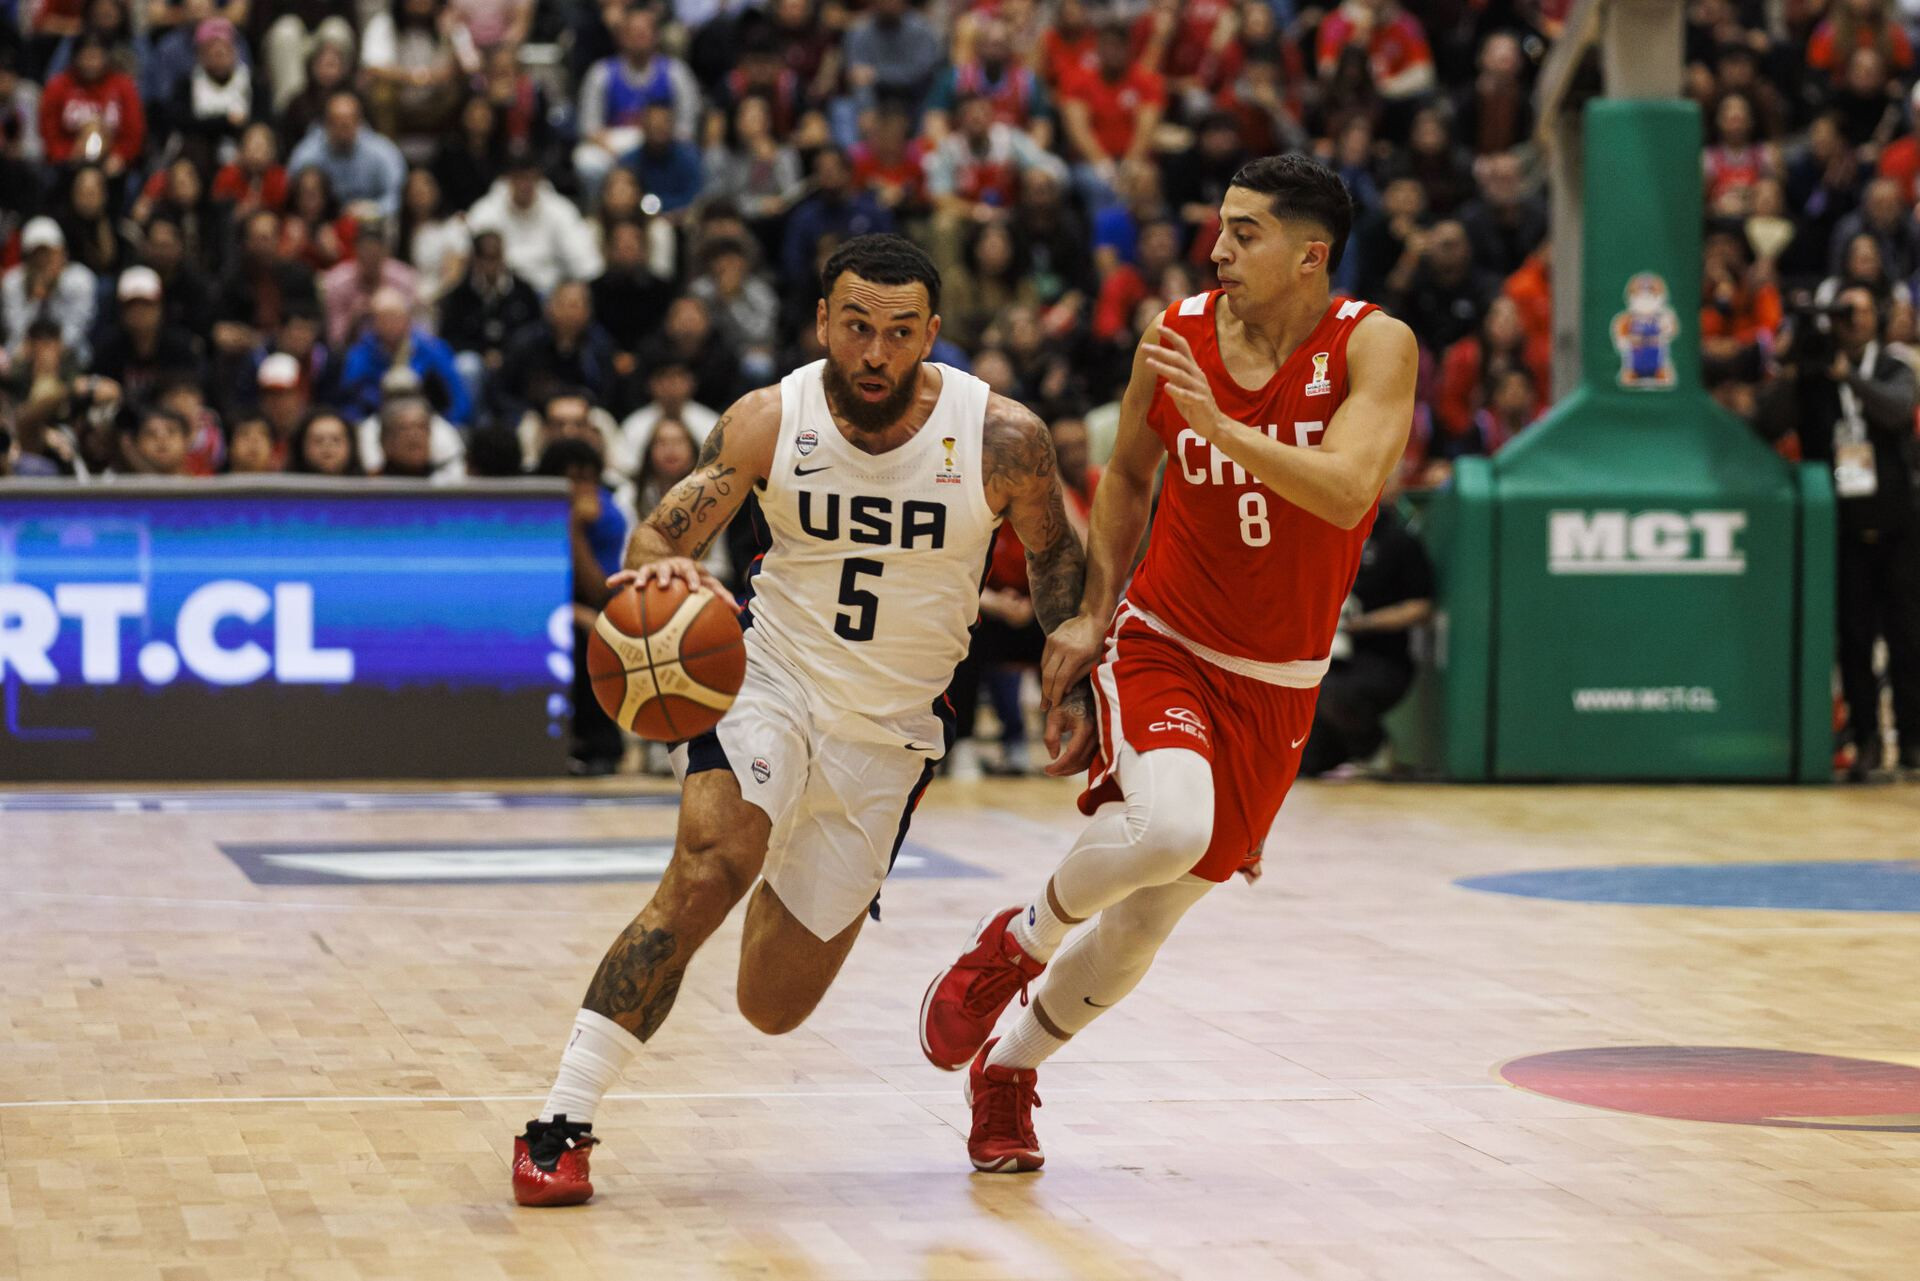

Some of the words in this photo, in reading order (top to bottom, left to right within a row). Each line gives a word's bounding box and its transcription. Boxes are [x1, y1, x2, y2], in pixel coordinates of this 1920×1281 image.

[799, 491, 946, 549] USA
[1238, 492, 1271, 547] 8
[1547, 510, 1747, 560] MCT
[834, 557, 884, 641] 5
